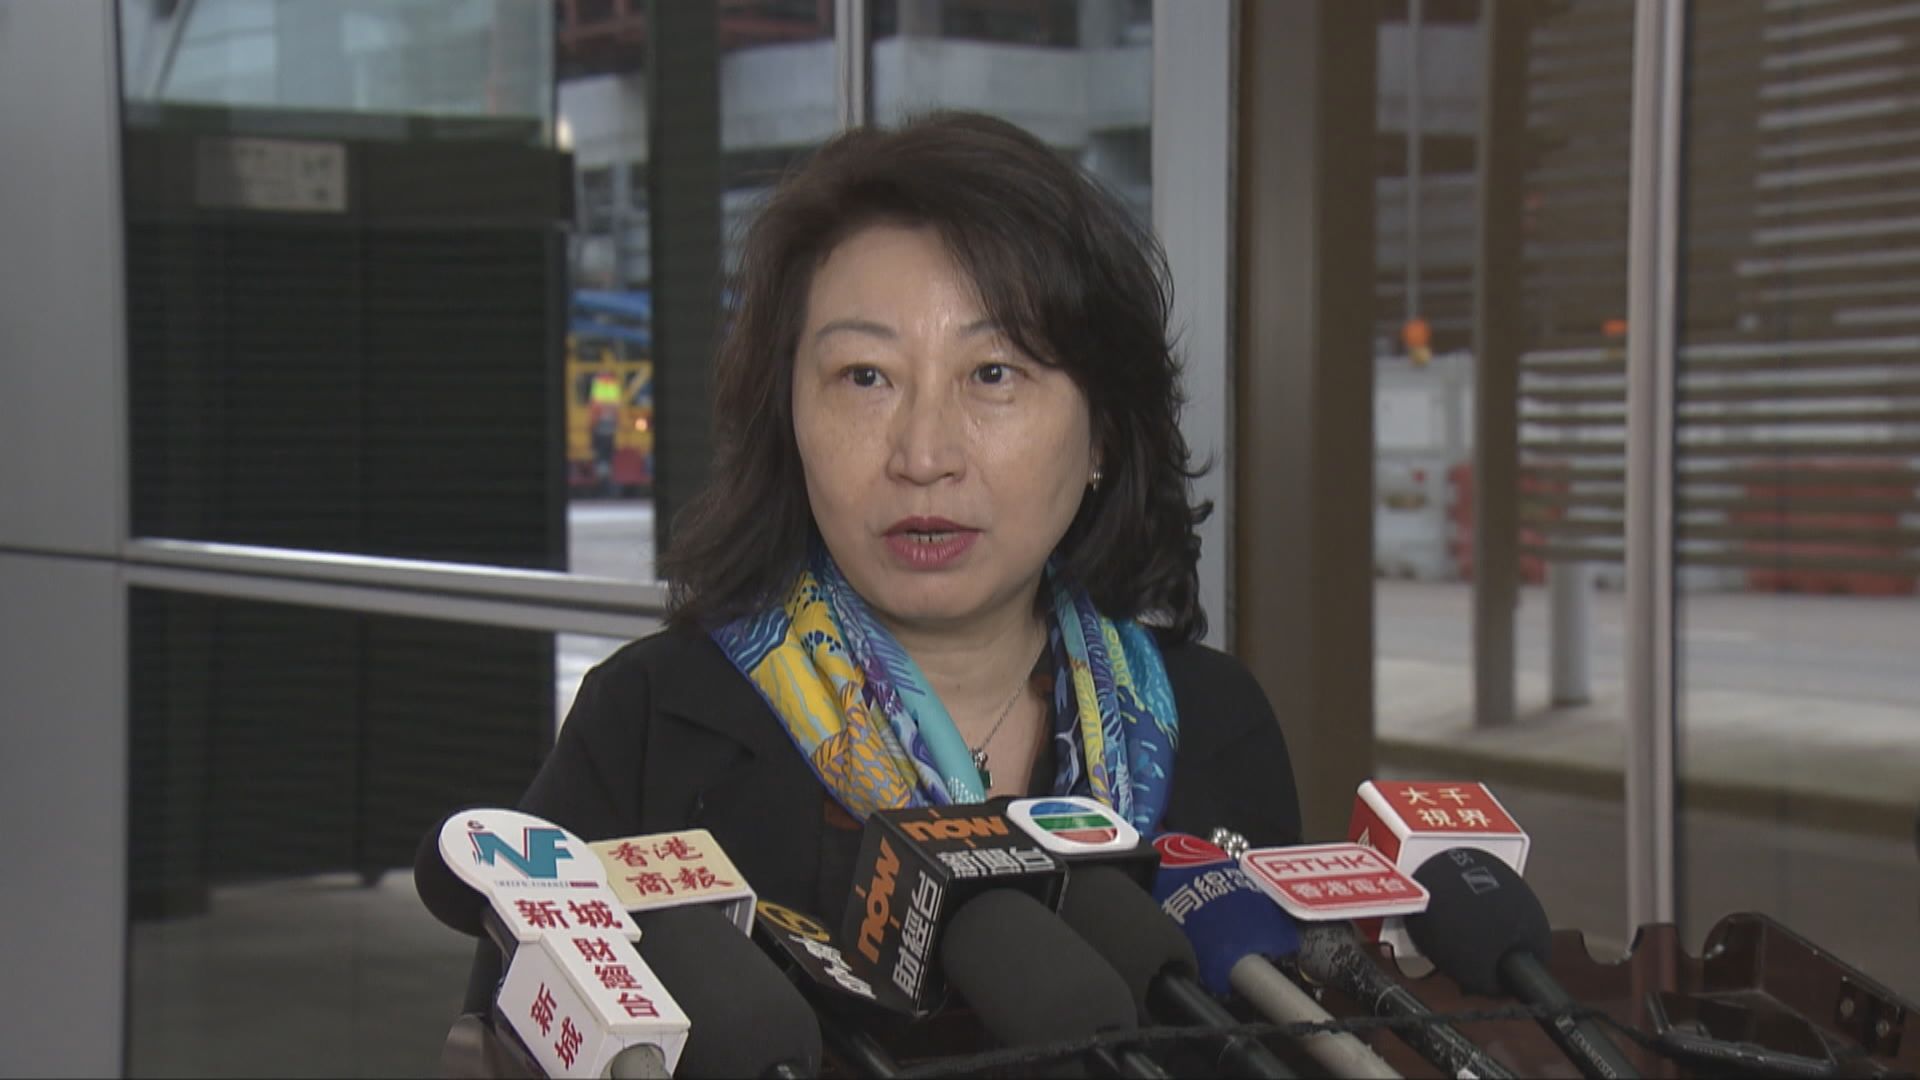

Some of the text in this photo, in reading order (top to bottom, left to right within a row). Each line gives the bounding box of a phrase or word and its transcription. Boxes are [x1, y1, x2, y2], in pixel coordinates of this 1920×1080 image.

[898, 814, 1010, 842] now
[1416, 807, 1492, 829] 視界
[608, 835, 704, 869] 香港
[936, 845, 1056, 879] 新聞台
[1264, 853, 1376, 874] RTHK
[625, 865, 735, 897] 商報
[1291, 876, 1408, 900] 香港電台
[513, 898, 624, 930] 新城
[859, 837, 901, 964] now
[892, 869, 943, 999] 財經台
[572, 937, 661, 1019] 財經台
[530, 983, 585, 1071] 新城
